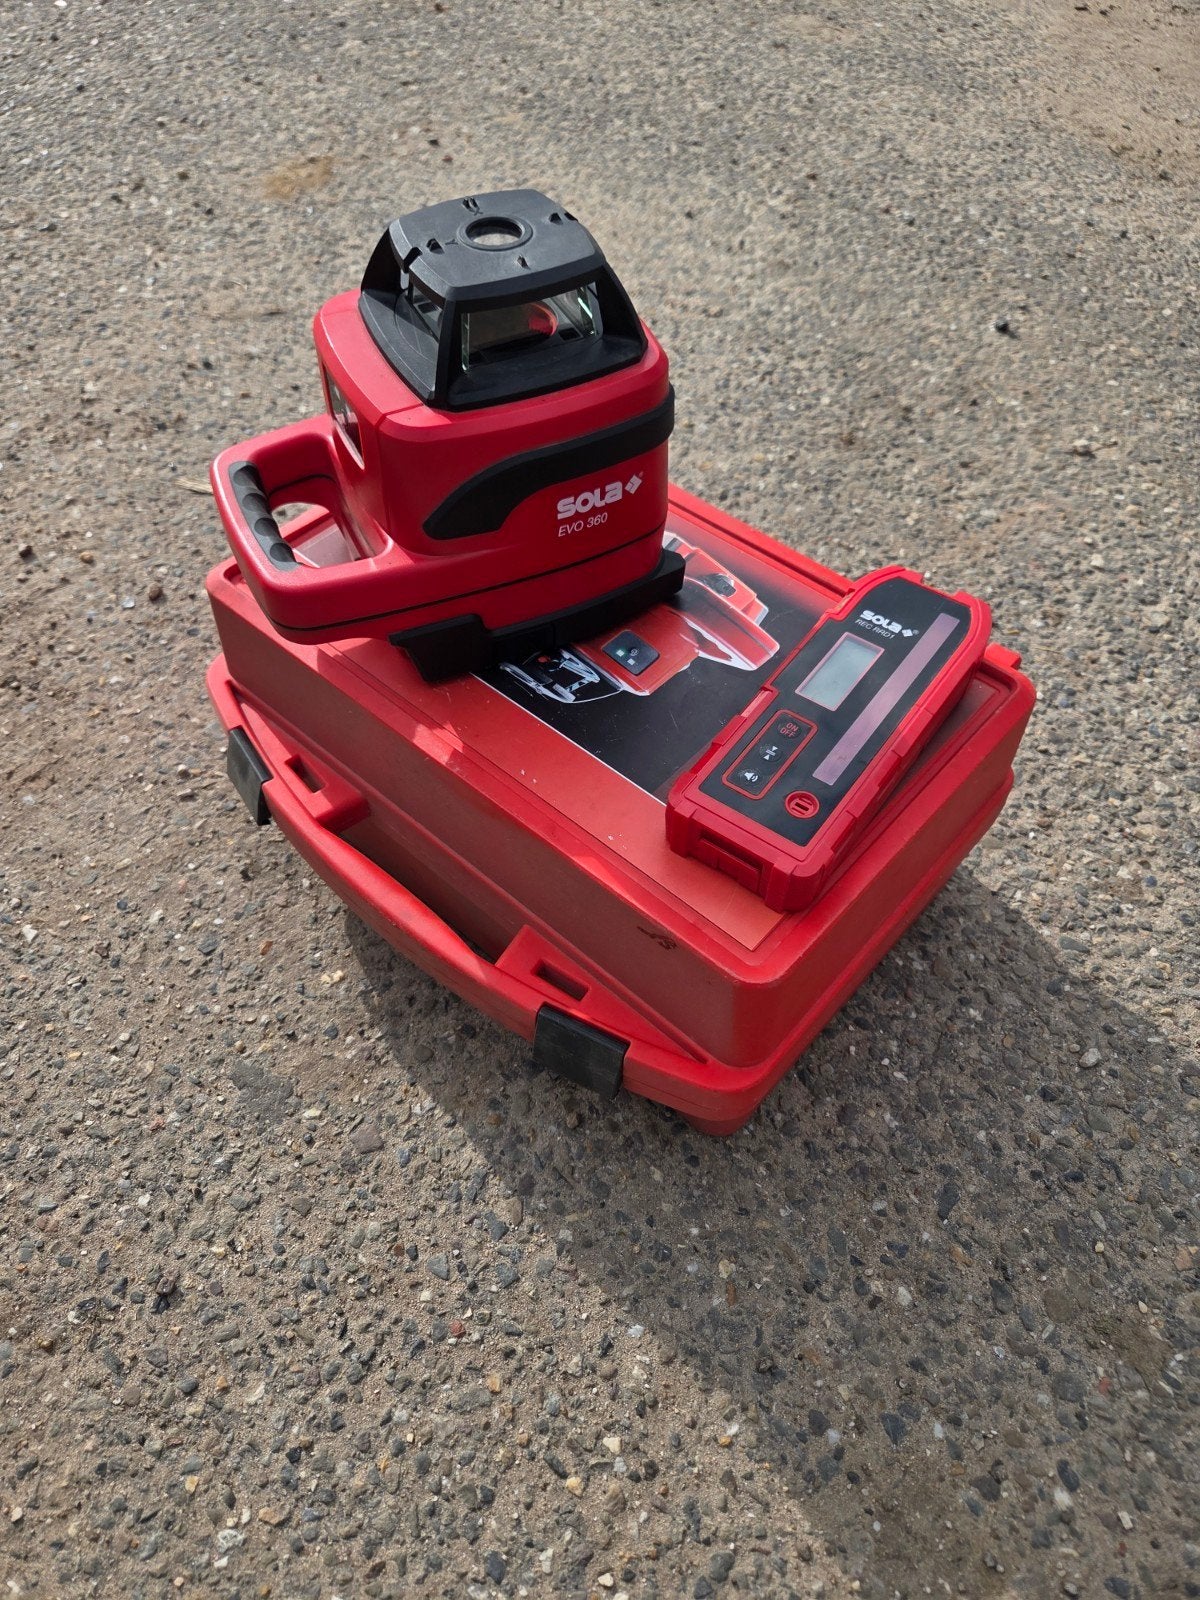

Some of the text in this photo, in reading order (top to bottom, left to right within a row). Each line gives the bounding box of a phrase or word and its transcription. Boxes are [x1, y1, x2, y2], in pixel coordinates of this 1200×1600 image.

[558, 512, 608, 538] EVO 360
[779, 727, 796, 738] OFF
[786, 722, 799, 732] ON
